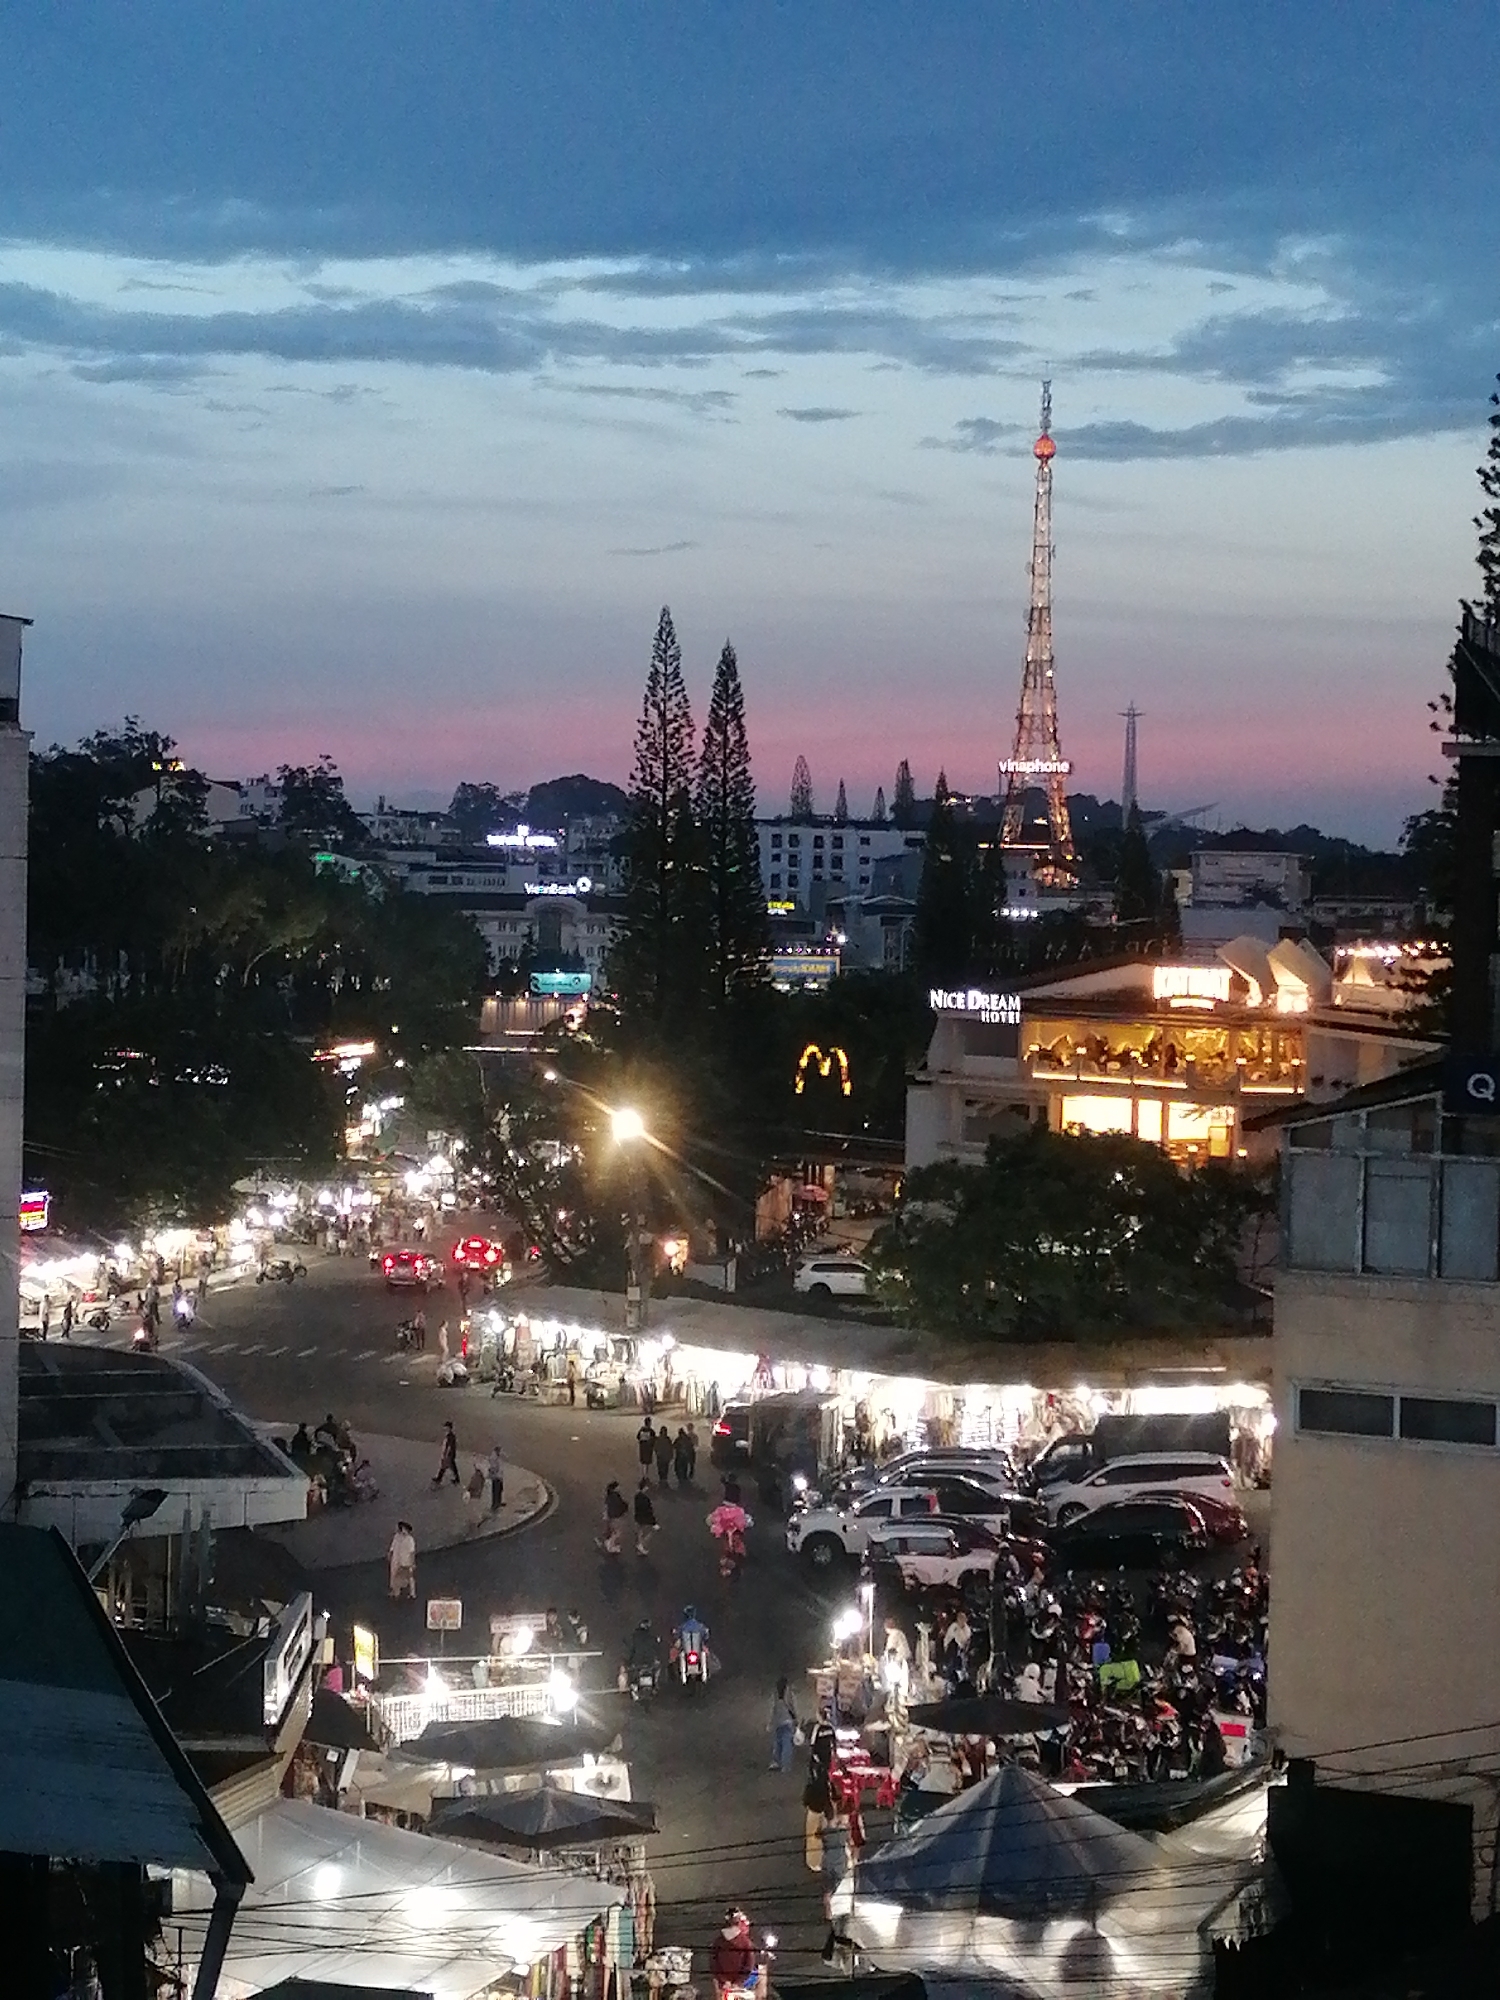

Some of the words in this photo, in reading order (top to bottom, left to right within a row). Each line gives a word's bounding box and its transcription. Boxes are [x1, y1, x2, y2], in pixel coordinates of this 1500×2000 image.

[999, 759, 1070, 773] vinaphone
[967, 990, 1020, 1011] DREAM
[981, 1011, 1020, 1024] HOTEL
[1467, 1073, 1495, 1102] Q
